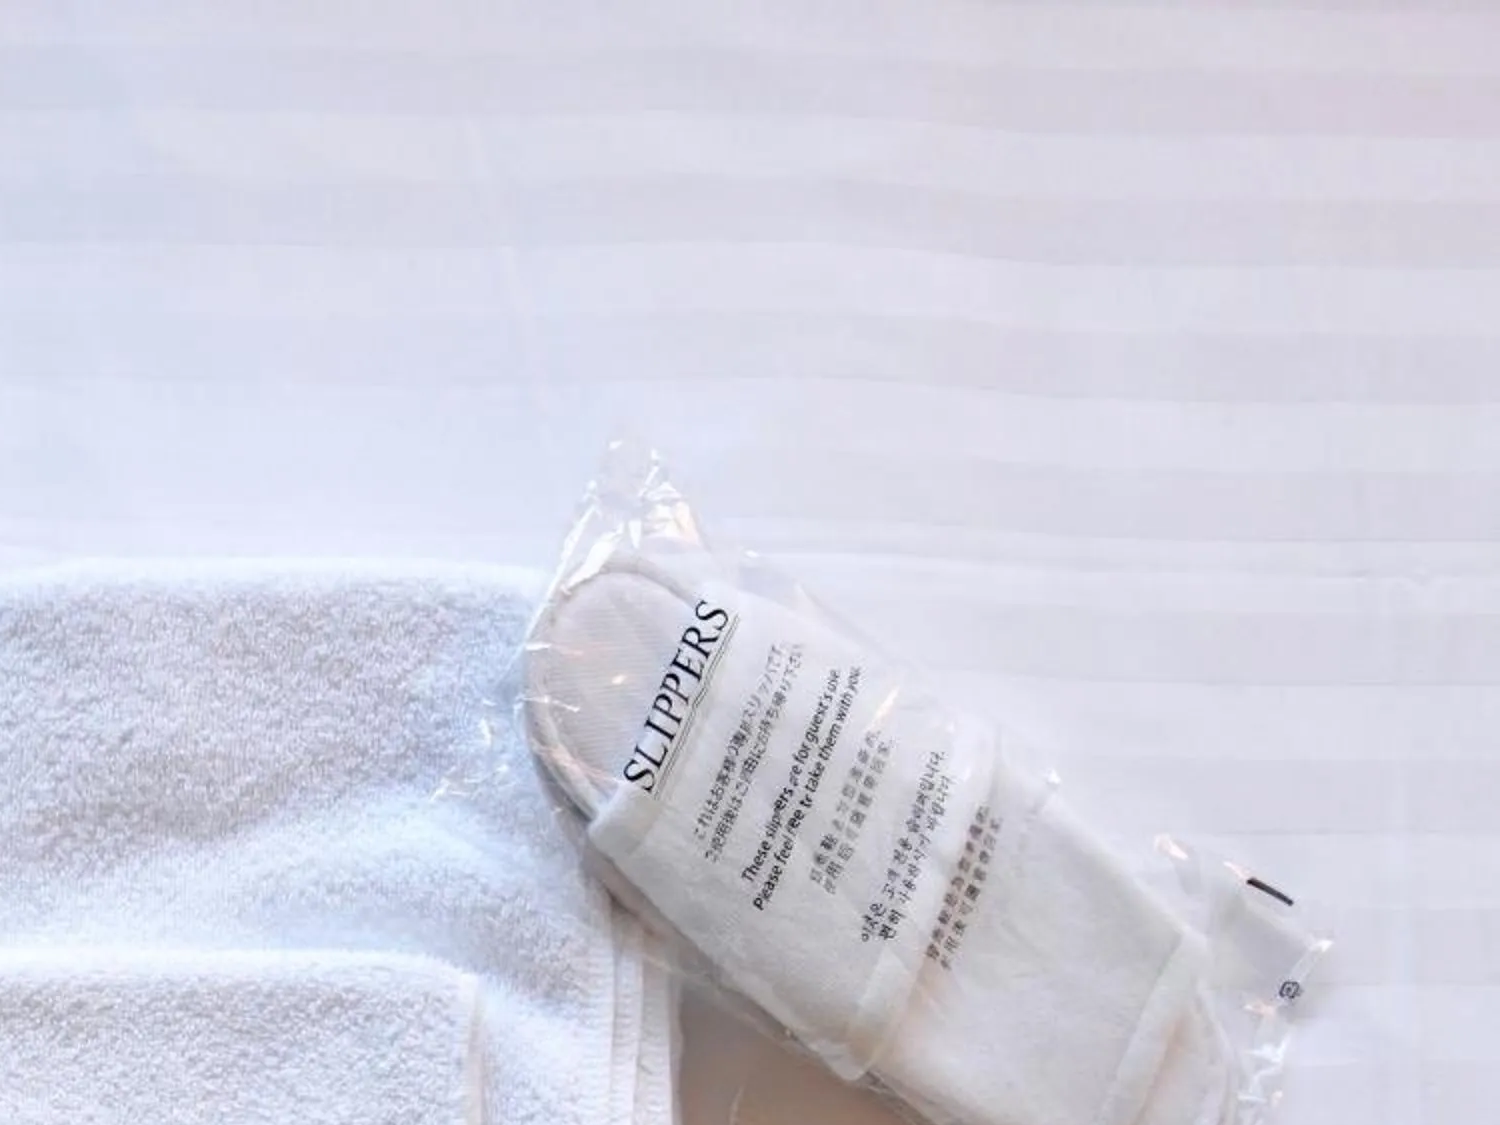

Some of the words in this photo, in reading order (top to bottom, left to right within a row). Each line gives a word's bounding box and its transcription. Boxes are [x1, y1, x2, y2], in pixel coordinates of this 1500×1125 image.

[623, 600, 728, 793] SLIPPERS
[805, 692, 833, 744] guest's
[789, 765, 802, 787] are
[792, 742, 813, 765] for
[753, 865, 782, 910] Please
[774, 834, 793, 865] feel
[785, 810, 805, 836] ree
[804, 762, 825, 793] take
[818, 724, 842, 761] them
[835, 692, 853, 722] with
[741, 840, 772, 882] These
